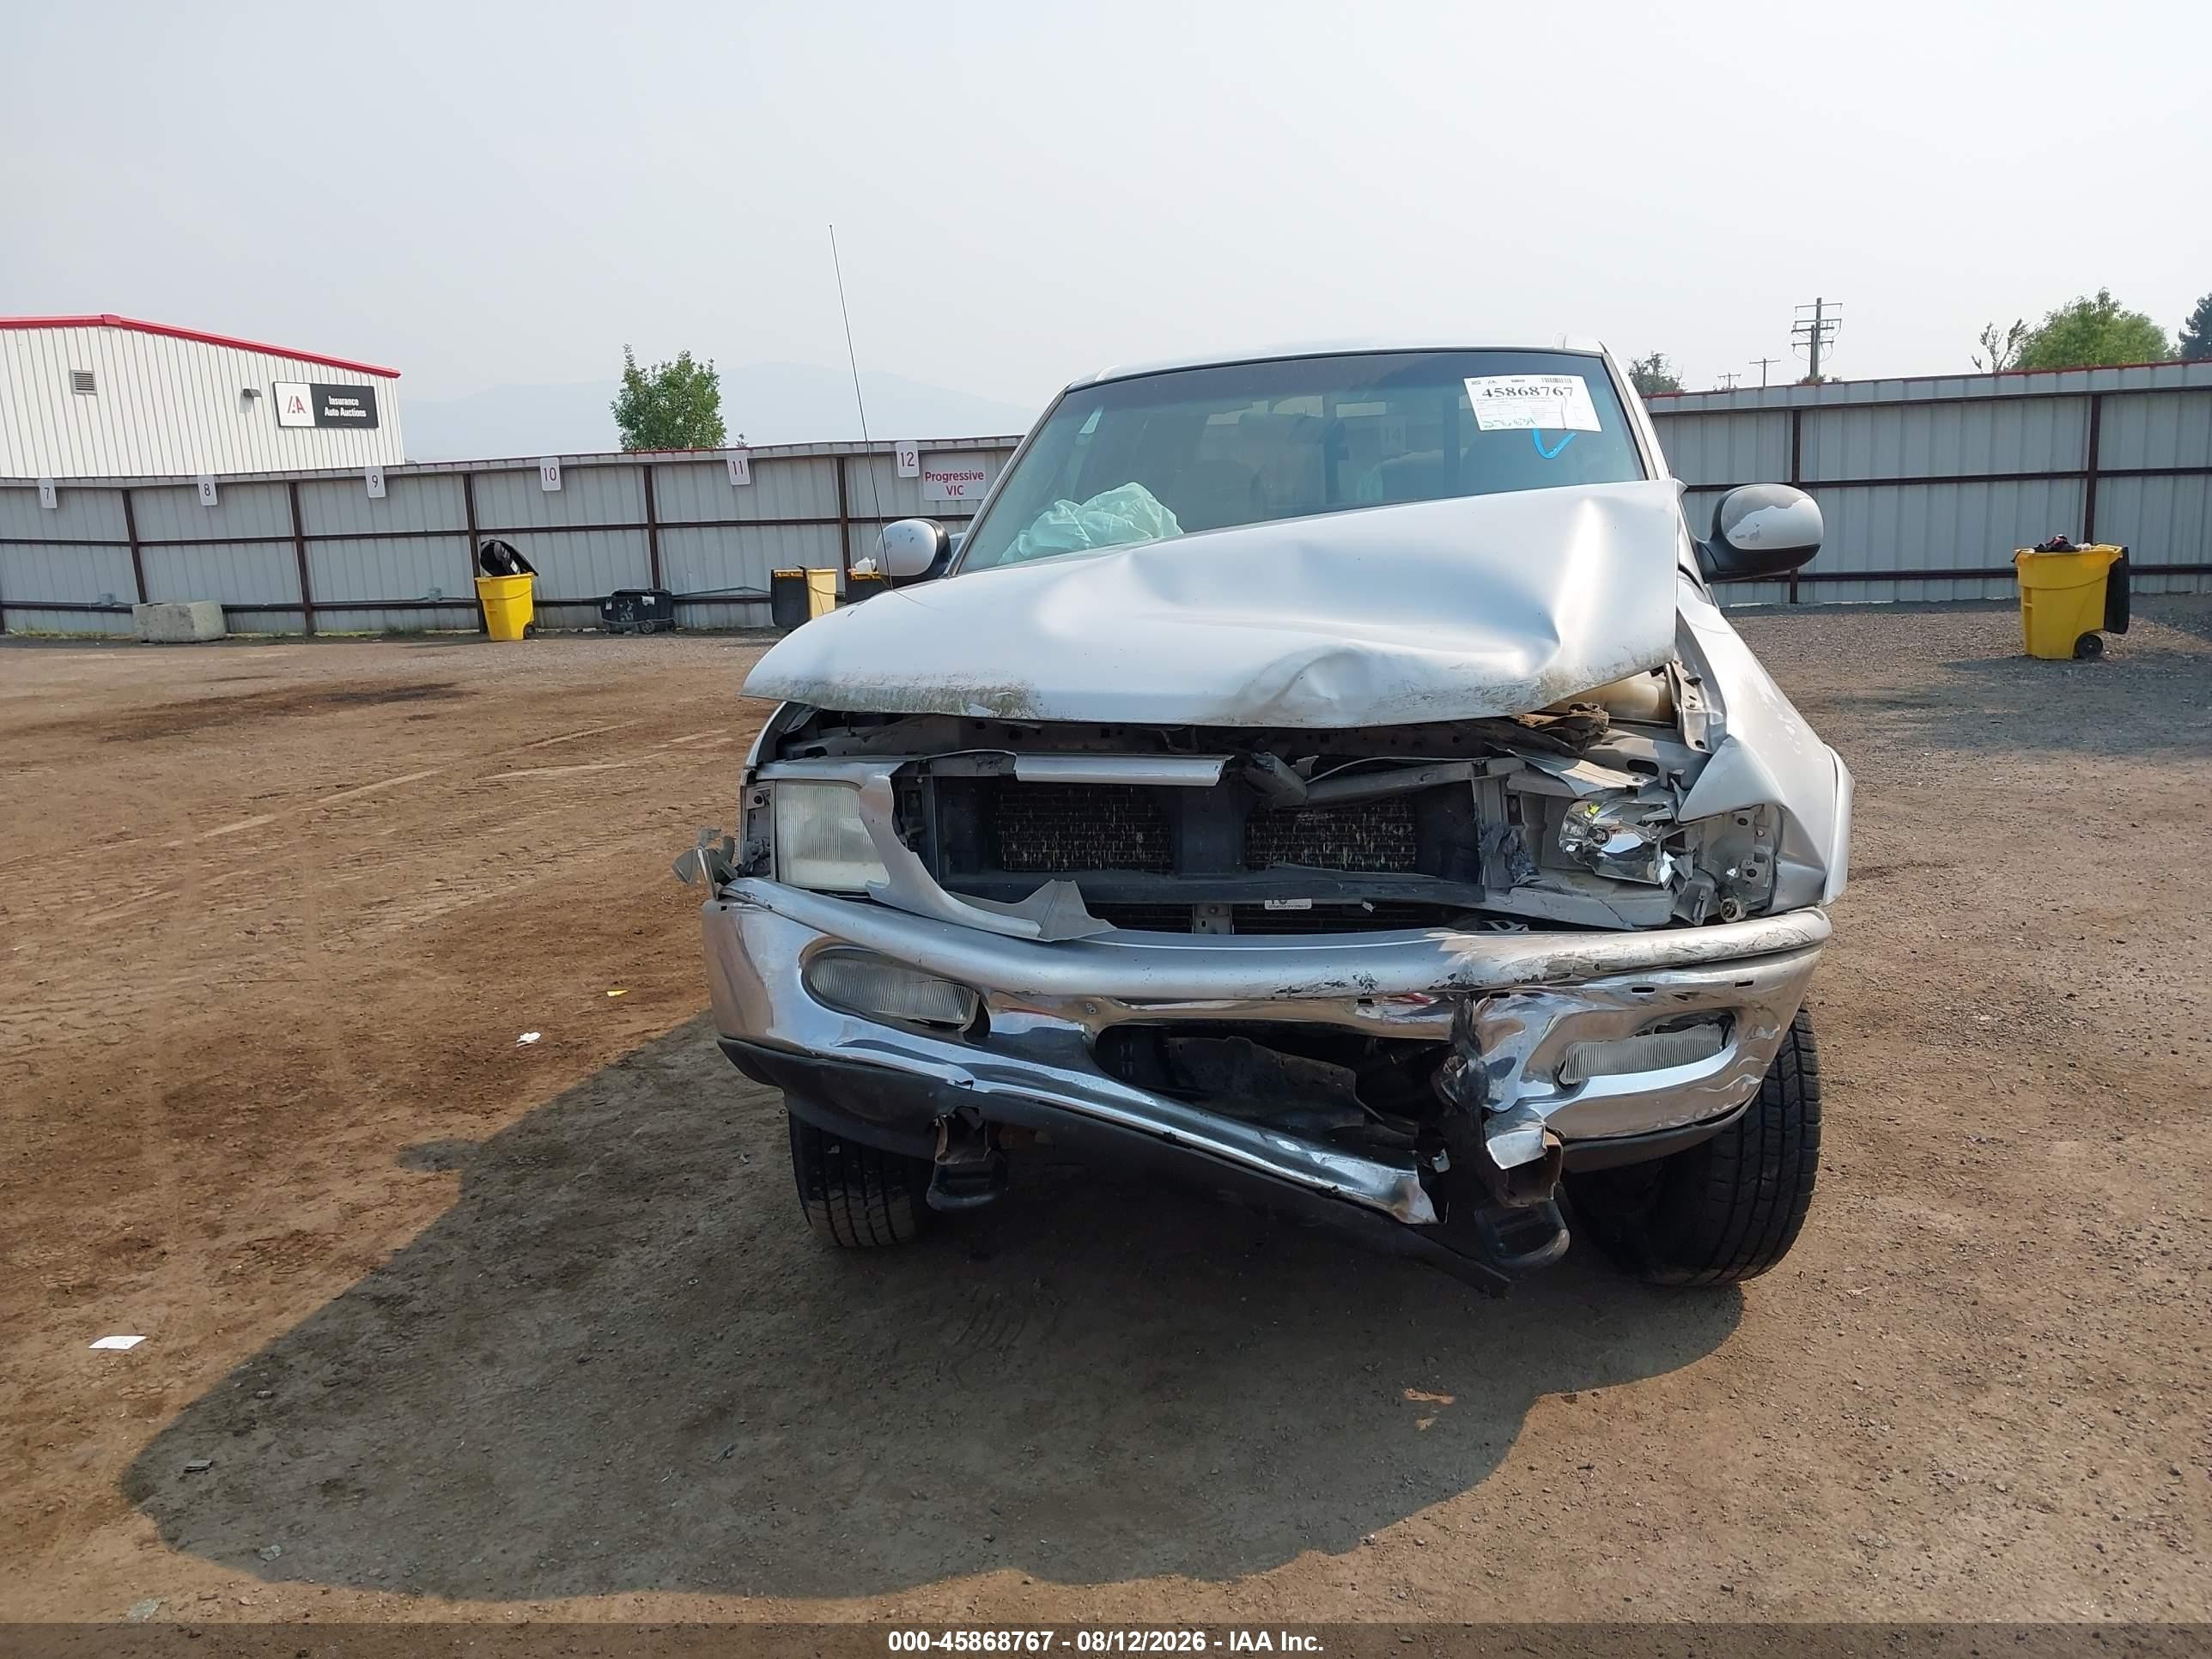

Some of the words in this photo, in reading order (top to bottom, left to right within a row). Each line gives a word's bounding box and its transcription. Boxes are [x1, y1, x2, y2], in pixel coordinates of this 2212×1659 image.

[1482, 386, 1573, 398] 45868767
[328, 395, 359, 406] Insurance
[324, 407, 339, 416] Auto
[340, 408, 367, 417] Auctions
[900, 452, 915, 467] 12
[544, 466, 557, 482] 10
[732, 459, 744, 476] 11
[372, 475, 379, 488] 9
[925, 470, 984, 483] Progressive
[44, 487, 51, 500] 7
[203, 483, 211, 496] 8
[945, 485, 964, 495] VIC
